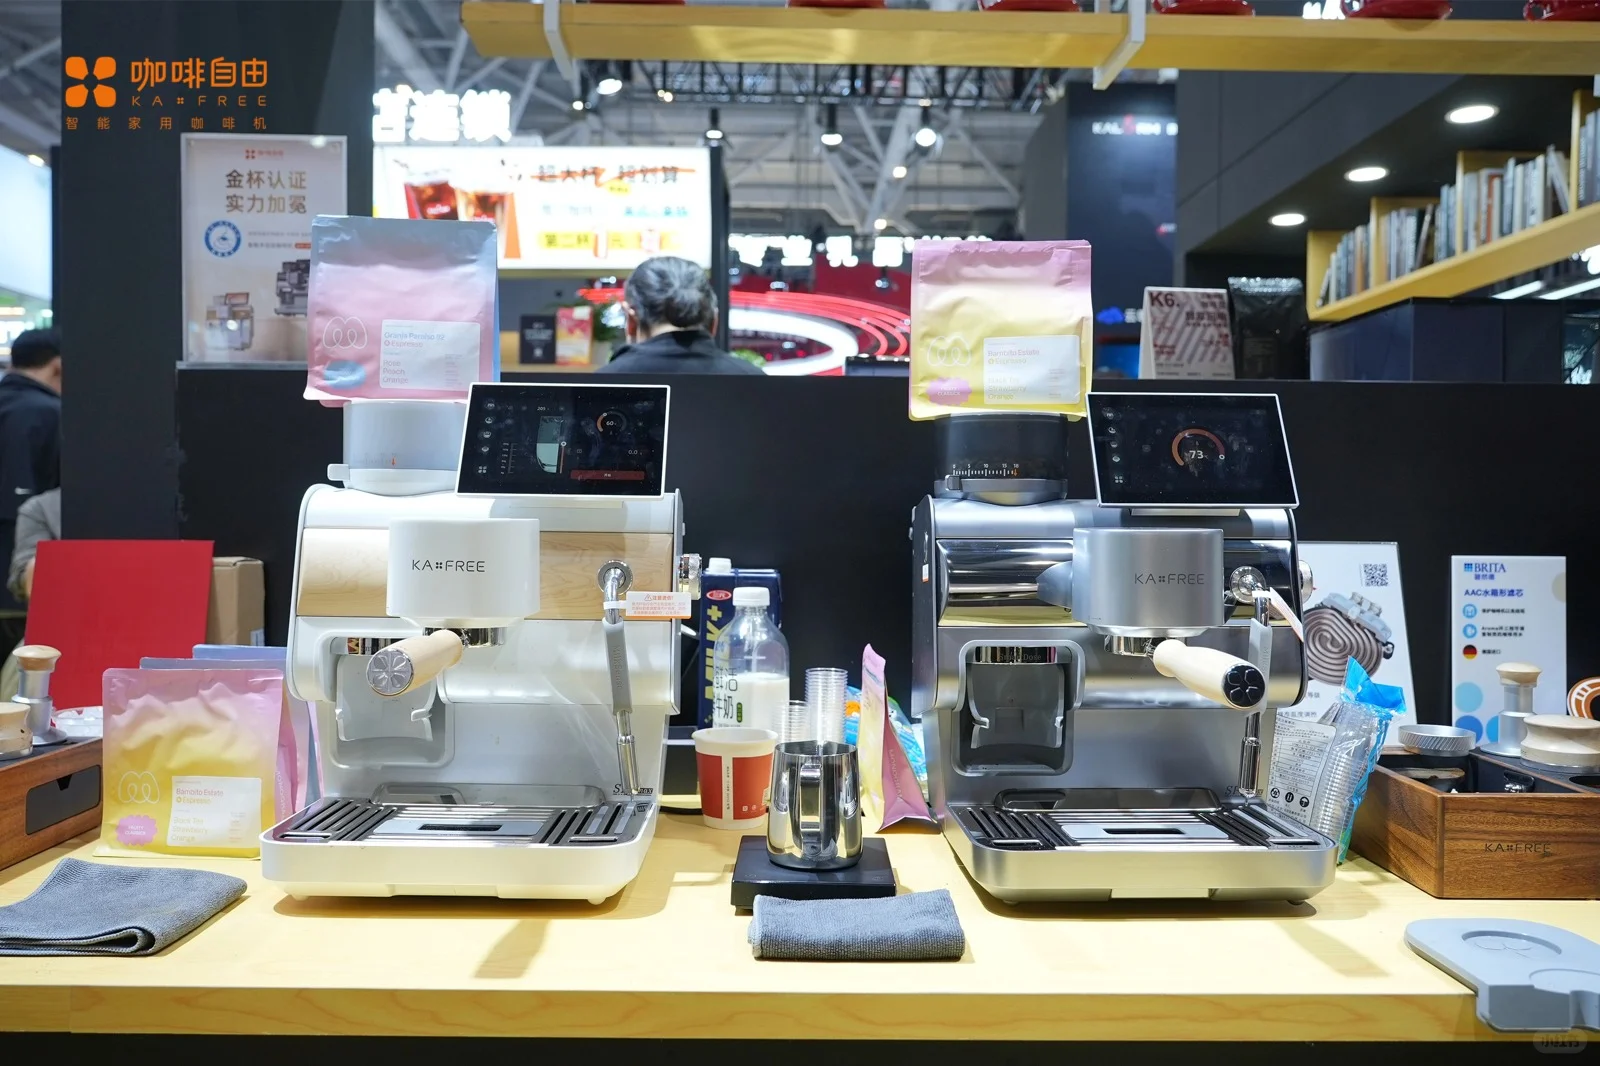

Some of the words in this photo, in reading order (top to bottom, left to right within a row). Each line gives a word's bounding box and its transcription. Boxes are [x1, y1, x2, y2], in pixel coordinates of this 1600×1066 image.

[130, 58, 268, 92] 咖啡自由
[66, 116, 267, 131] 智能家用咖啡机
[226, 169, 307, 190] 金杯认证
[1189, 449, 1205, 460] 73
[1474, 562, 1507, 574] BRITA
